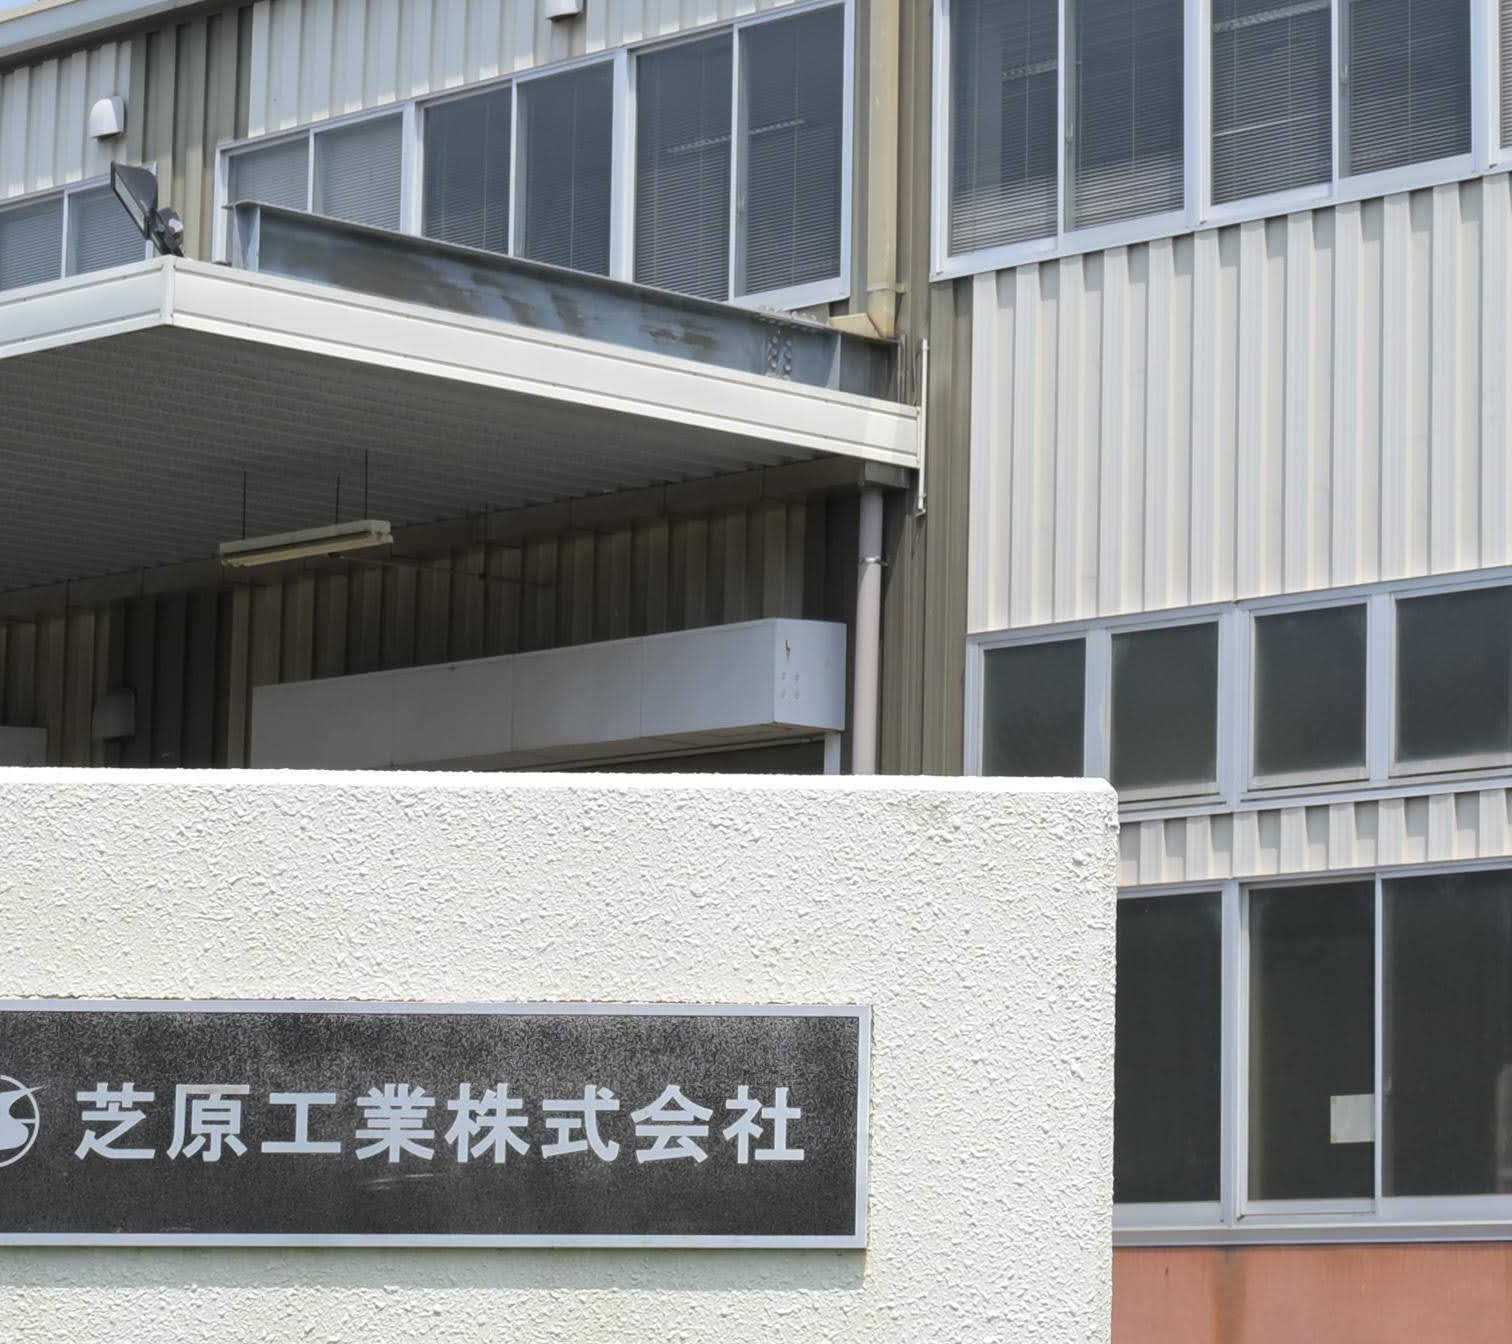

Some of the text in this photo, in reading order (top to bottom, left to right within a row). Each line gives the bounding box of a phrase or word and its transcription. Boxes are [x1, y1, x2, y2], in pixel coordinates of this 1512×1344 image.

[75, 1082, 805, 1164] 芝原工業株式会社
